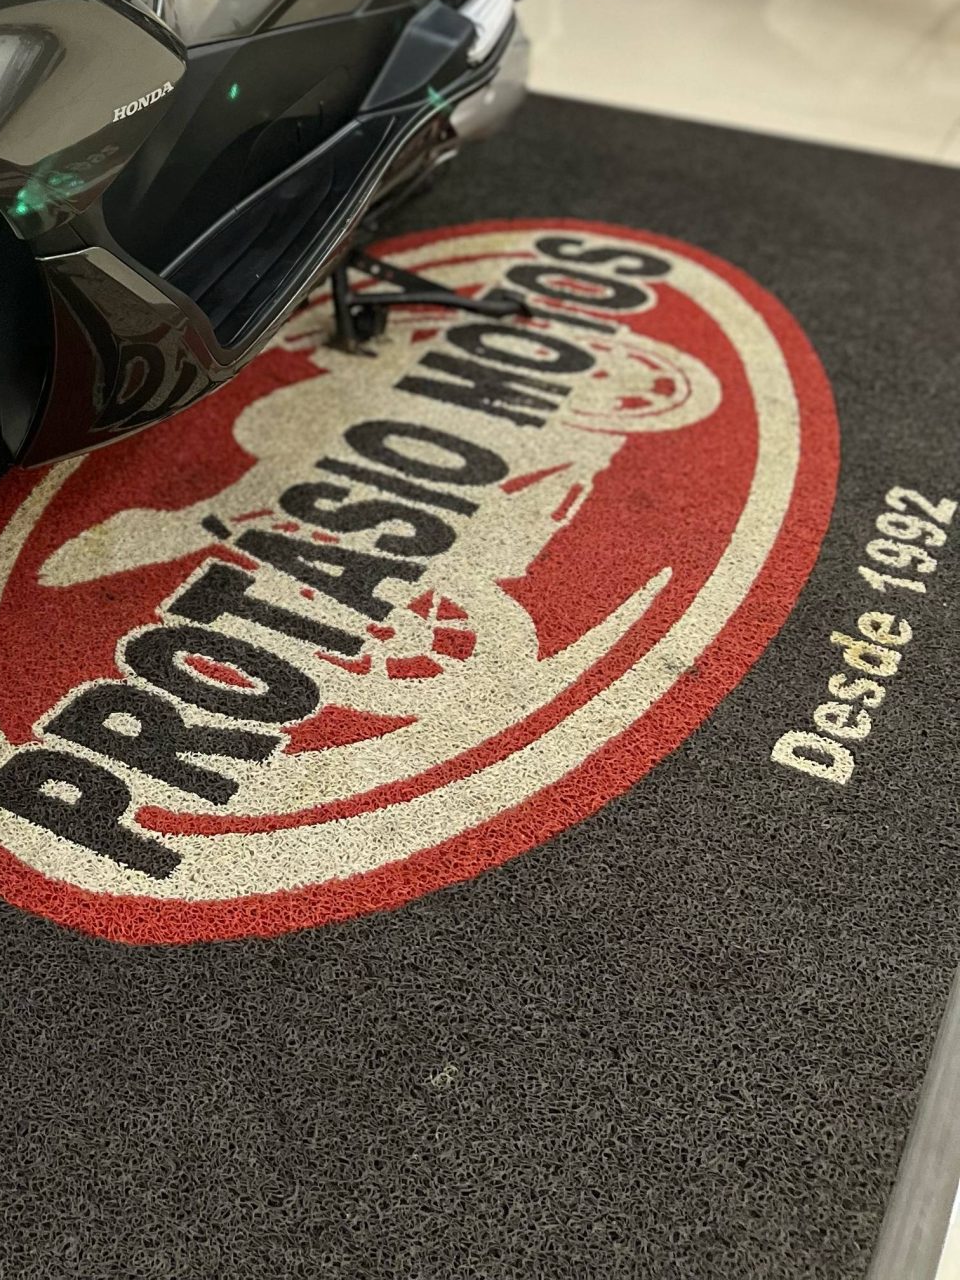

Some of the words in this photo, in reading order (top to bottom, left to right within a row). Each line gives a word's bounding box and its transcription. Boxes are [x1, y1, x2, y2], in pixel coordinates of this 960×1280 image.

[113, 81, 174, 122] HONDA
[393, 236, 672, 429] MOTOS
[771, 611, 914, 786] Desde
[858, 485, 959, 594] 1992
